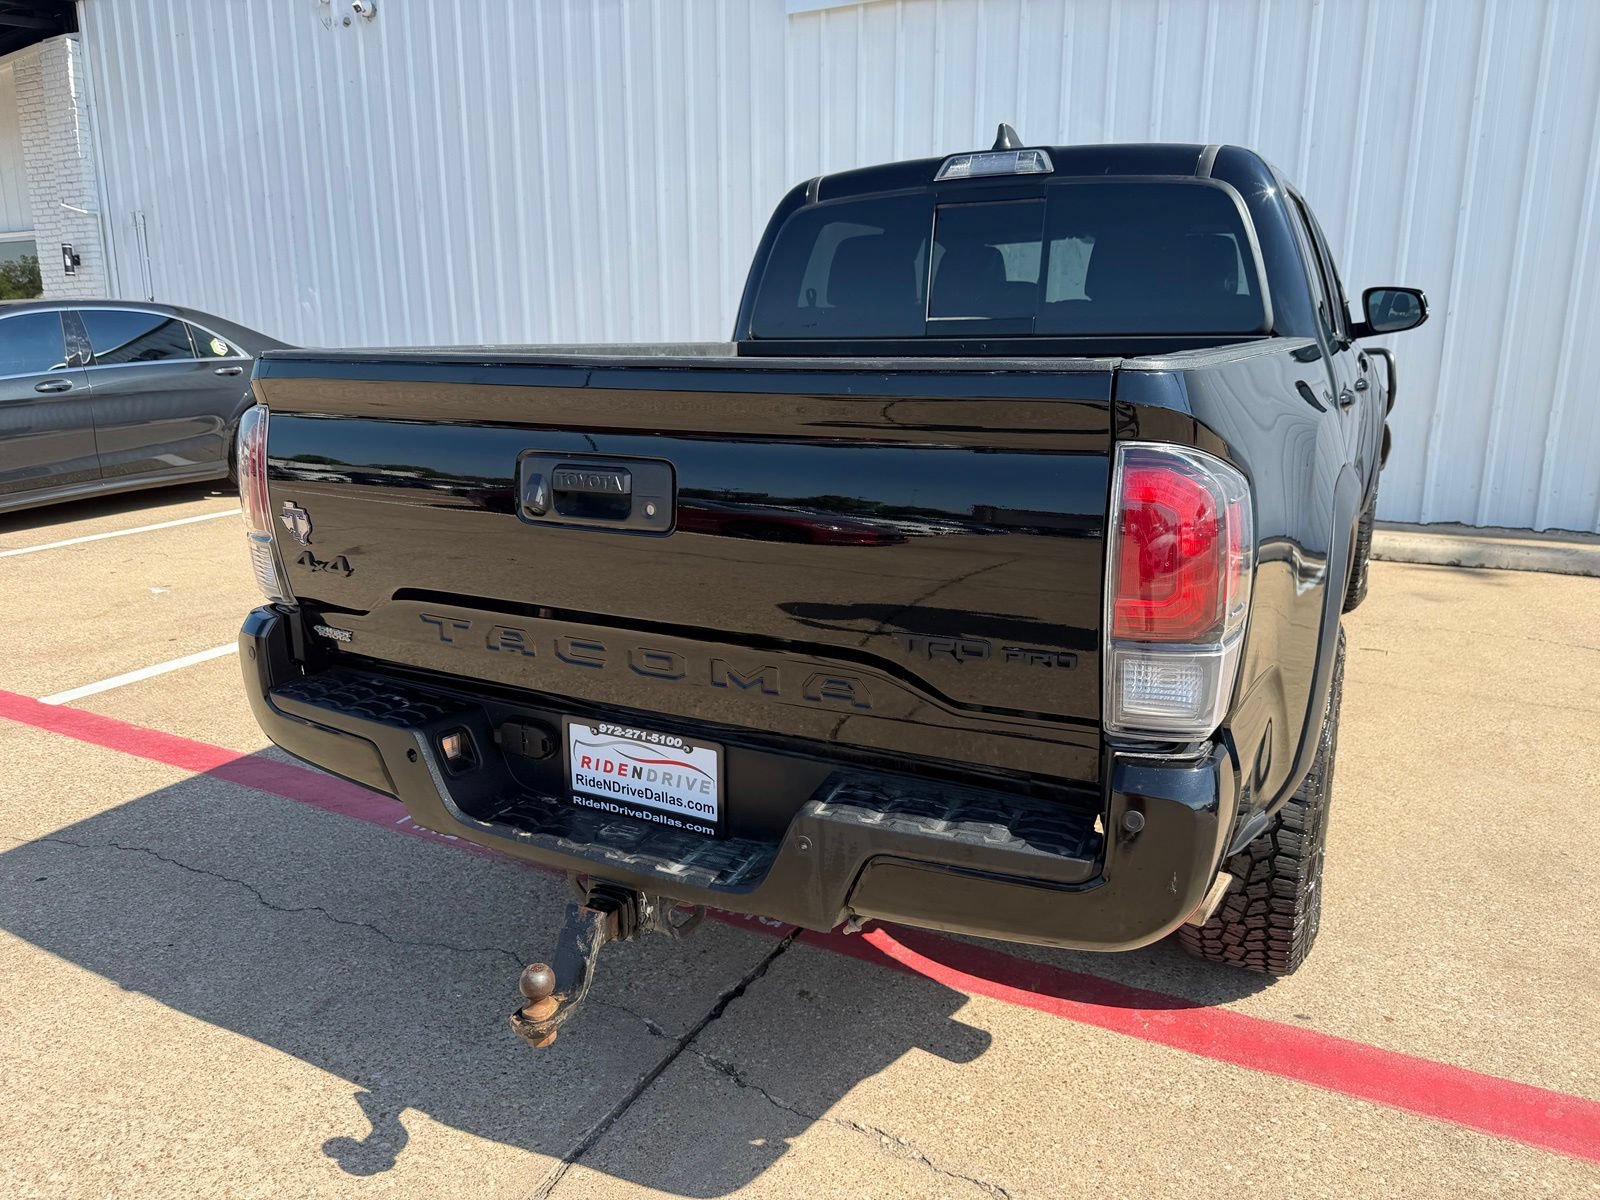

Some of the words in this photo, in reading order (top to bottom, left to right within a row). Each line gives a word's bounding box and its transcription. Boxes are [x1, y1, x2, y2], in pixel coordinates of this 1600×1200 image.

[556, 472, 622, 491] TOYOTA
[419, 613, 873, 709] TACOMA
[894, 632, 991, 665] TRD
[1001, 646, 1079, 671] PRO
[598, 723, 683, 748] 972-271-5100
[575, 773, 715, 815] RideNDriveDallas.com
[581, 755, 712, 795] RIDENDRIVE
[572, 795, 715, 836] RideNDriveDallas.com
